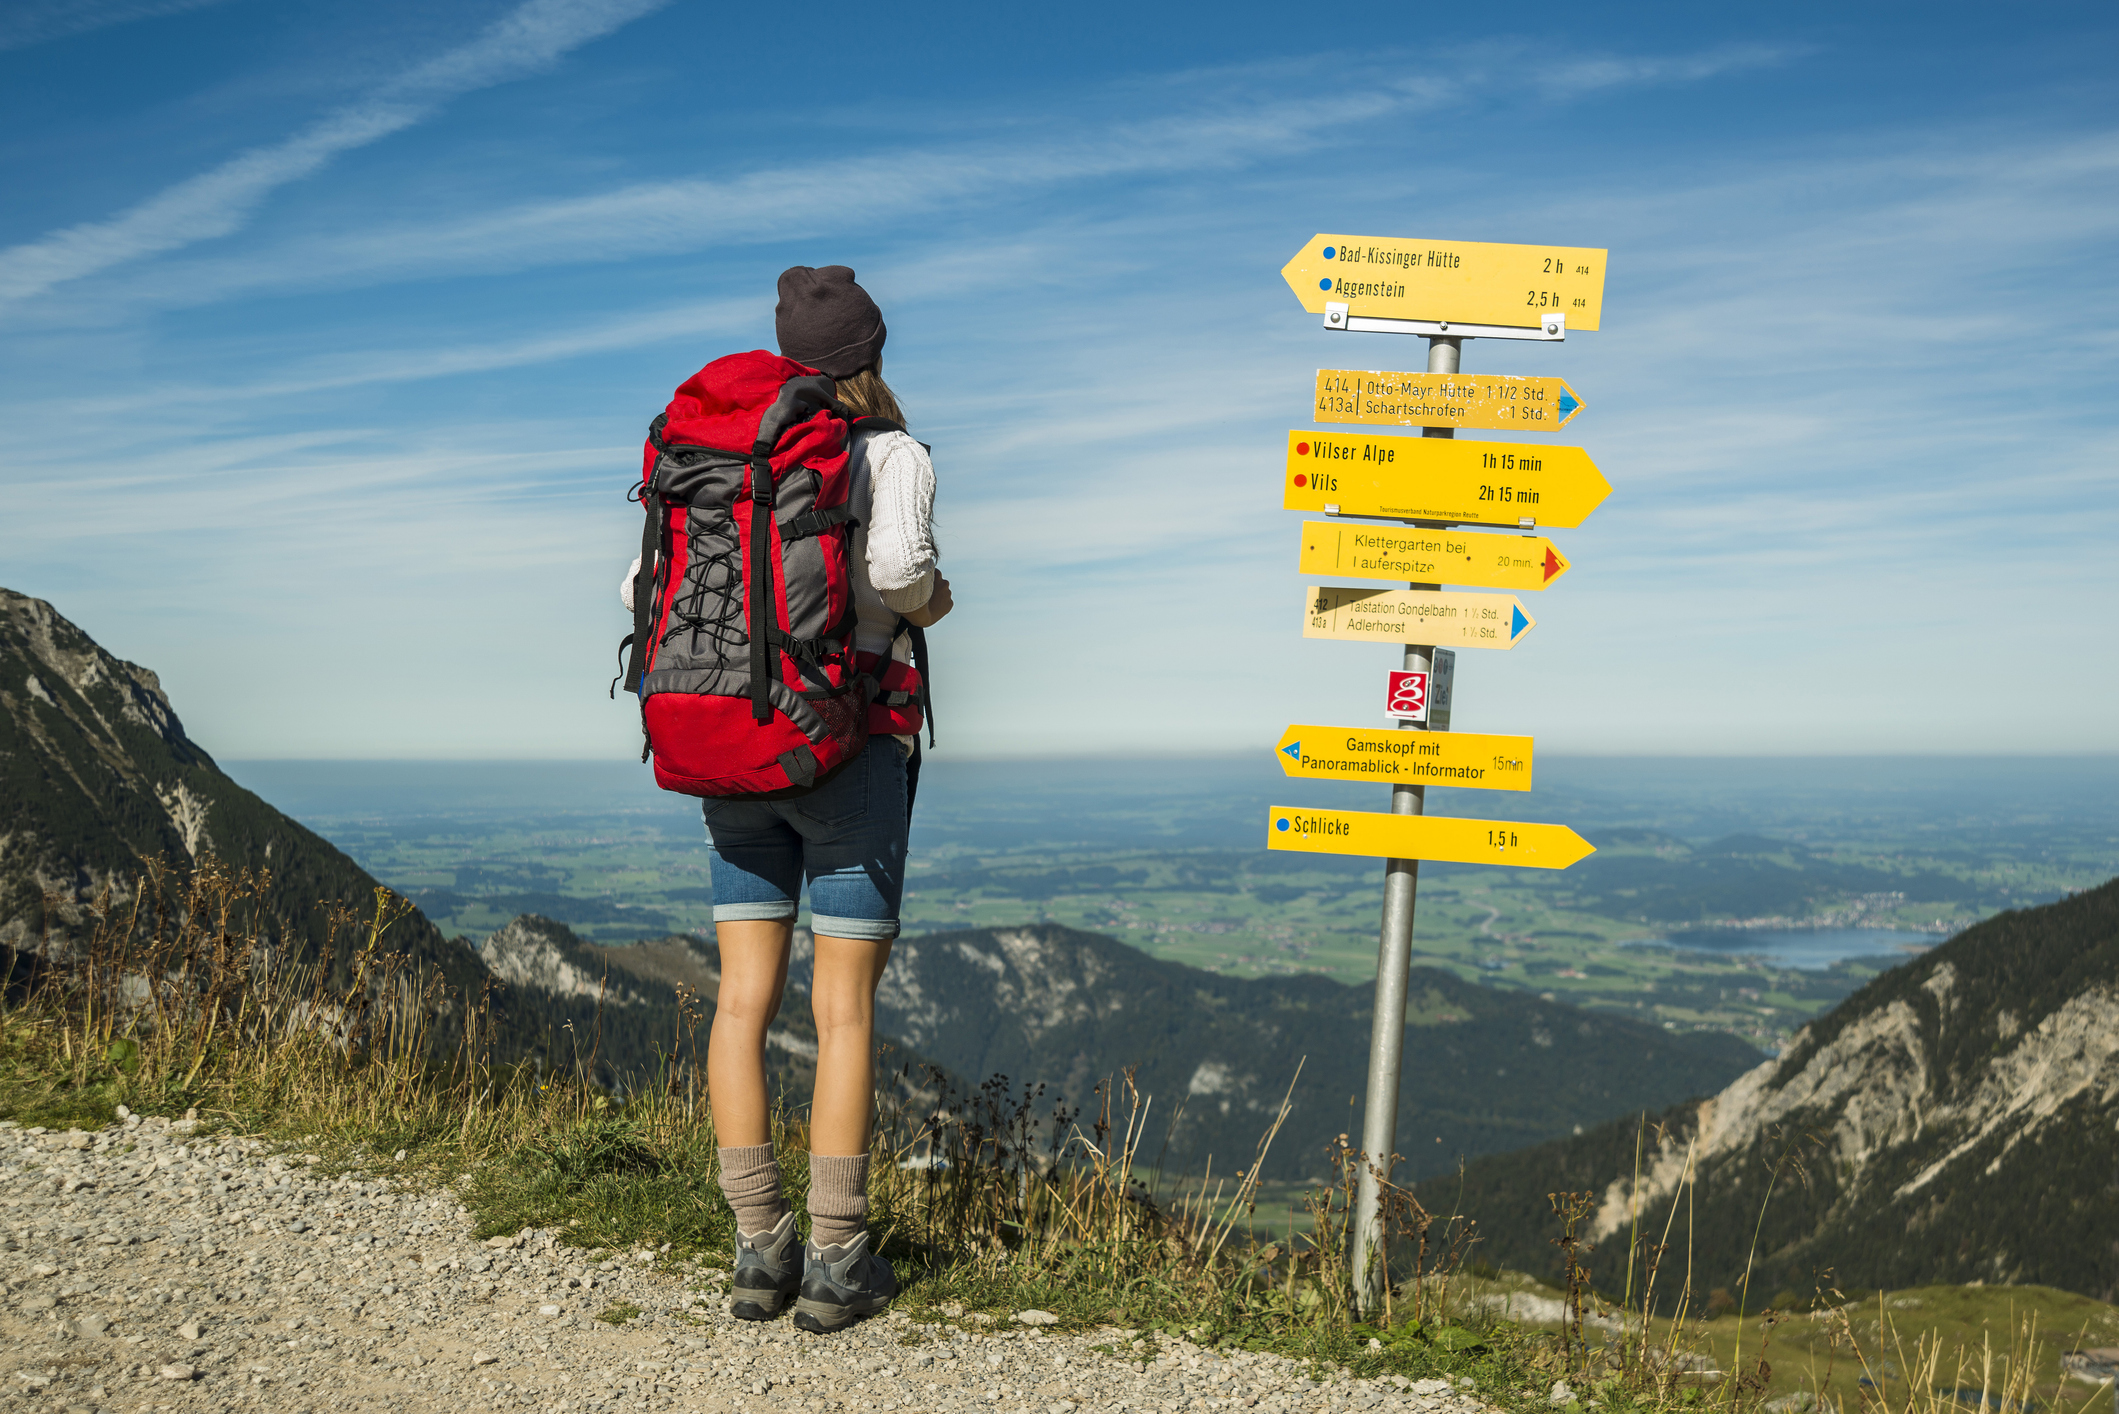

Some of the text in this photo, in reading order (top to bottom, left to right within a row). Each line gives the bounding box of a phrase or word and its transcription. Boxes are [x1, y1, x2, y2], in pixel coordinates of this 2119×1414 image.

[1339, 245, 1460, 269] Bad-Kissinger Hütte
[1543, 258, 1563, 274] 2 h
[1576, 265, 1589, 275] 414
[1335, 277, 1405, 299] Aggenstein
[1527, 290, 1560, 308] 2,5 h
[1572, 298, 1586, 308] 414
[1325, 378, 1349, 393] 414
[1367, 381, 1475, 400] Otto-Mayr Hütte
[1487, 386, 1548, 401] 1 1/2 Std.
[1319, 397, 1353, 413] 413a
[1366, 401, 1465, 417] Schartschrofen
[1510, 406, 1516, 419] 1
[1522, 407, 1547, 420] Std.
[1314, 441, 1395, 465] Vilser Alpe
[1483, 453, 1542, 471] 1h 15 min
[1311, 473, 1338, 491] Vils
[1479, 485, 1540, 504] 2h 15 min
[1379, 505, 1422, 515] Tourismusverband
[1423, 509, 1462, 518] Naturparkregion
[1355, 534, 1466, 554] Klettergarten bei
[1497, 556, 1510, 567] 20
[1314, 598, 1328, 611] 412
[1350, 600, 1457, 617] Talstation Gondelbahn
[1464, 608, 1468, 618] 1
[1481, 608, 1499, 620] Std.
[1346, 618, 1405, 633] Adlerhorst
[1463, 627, 1467, 637] 1
[1480, 627, 1498, 639] Std.
[1346, 737, 1440, 757] Gamskopf mit
[1301, 756, 1400, 774] Panoramablick
[1412, 761, 1485, 779] Informator
[1294, 815, 1350, 836] Schlicke
[1488, 830, 1518, 847] 1,5 h
